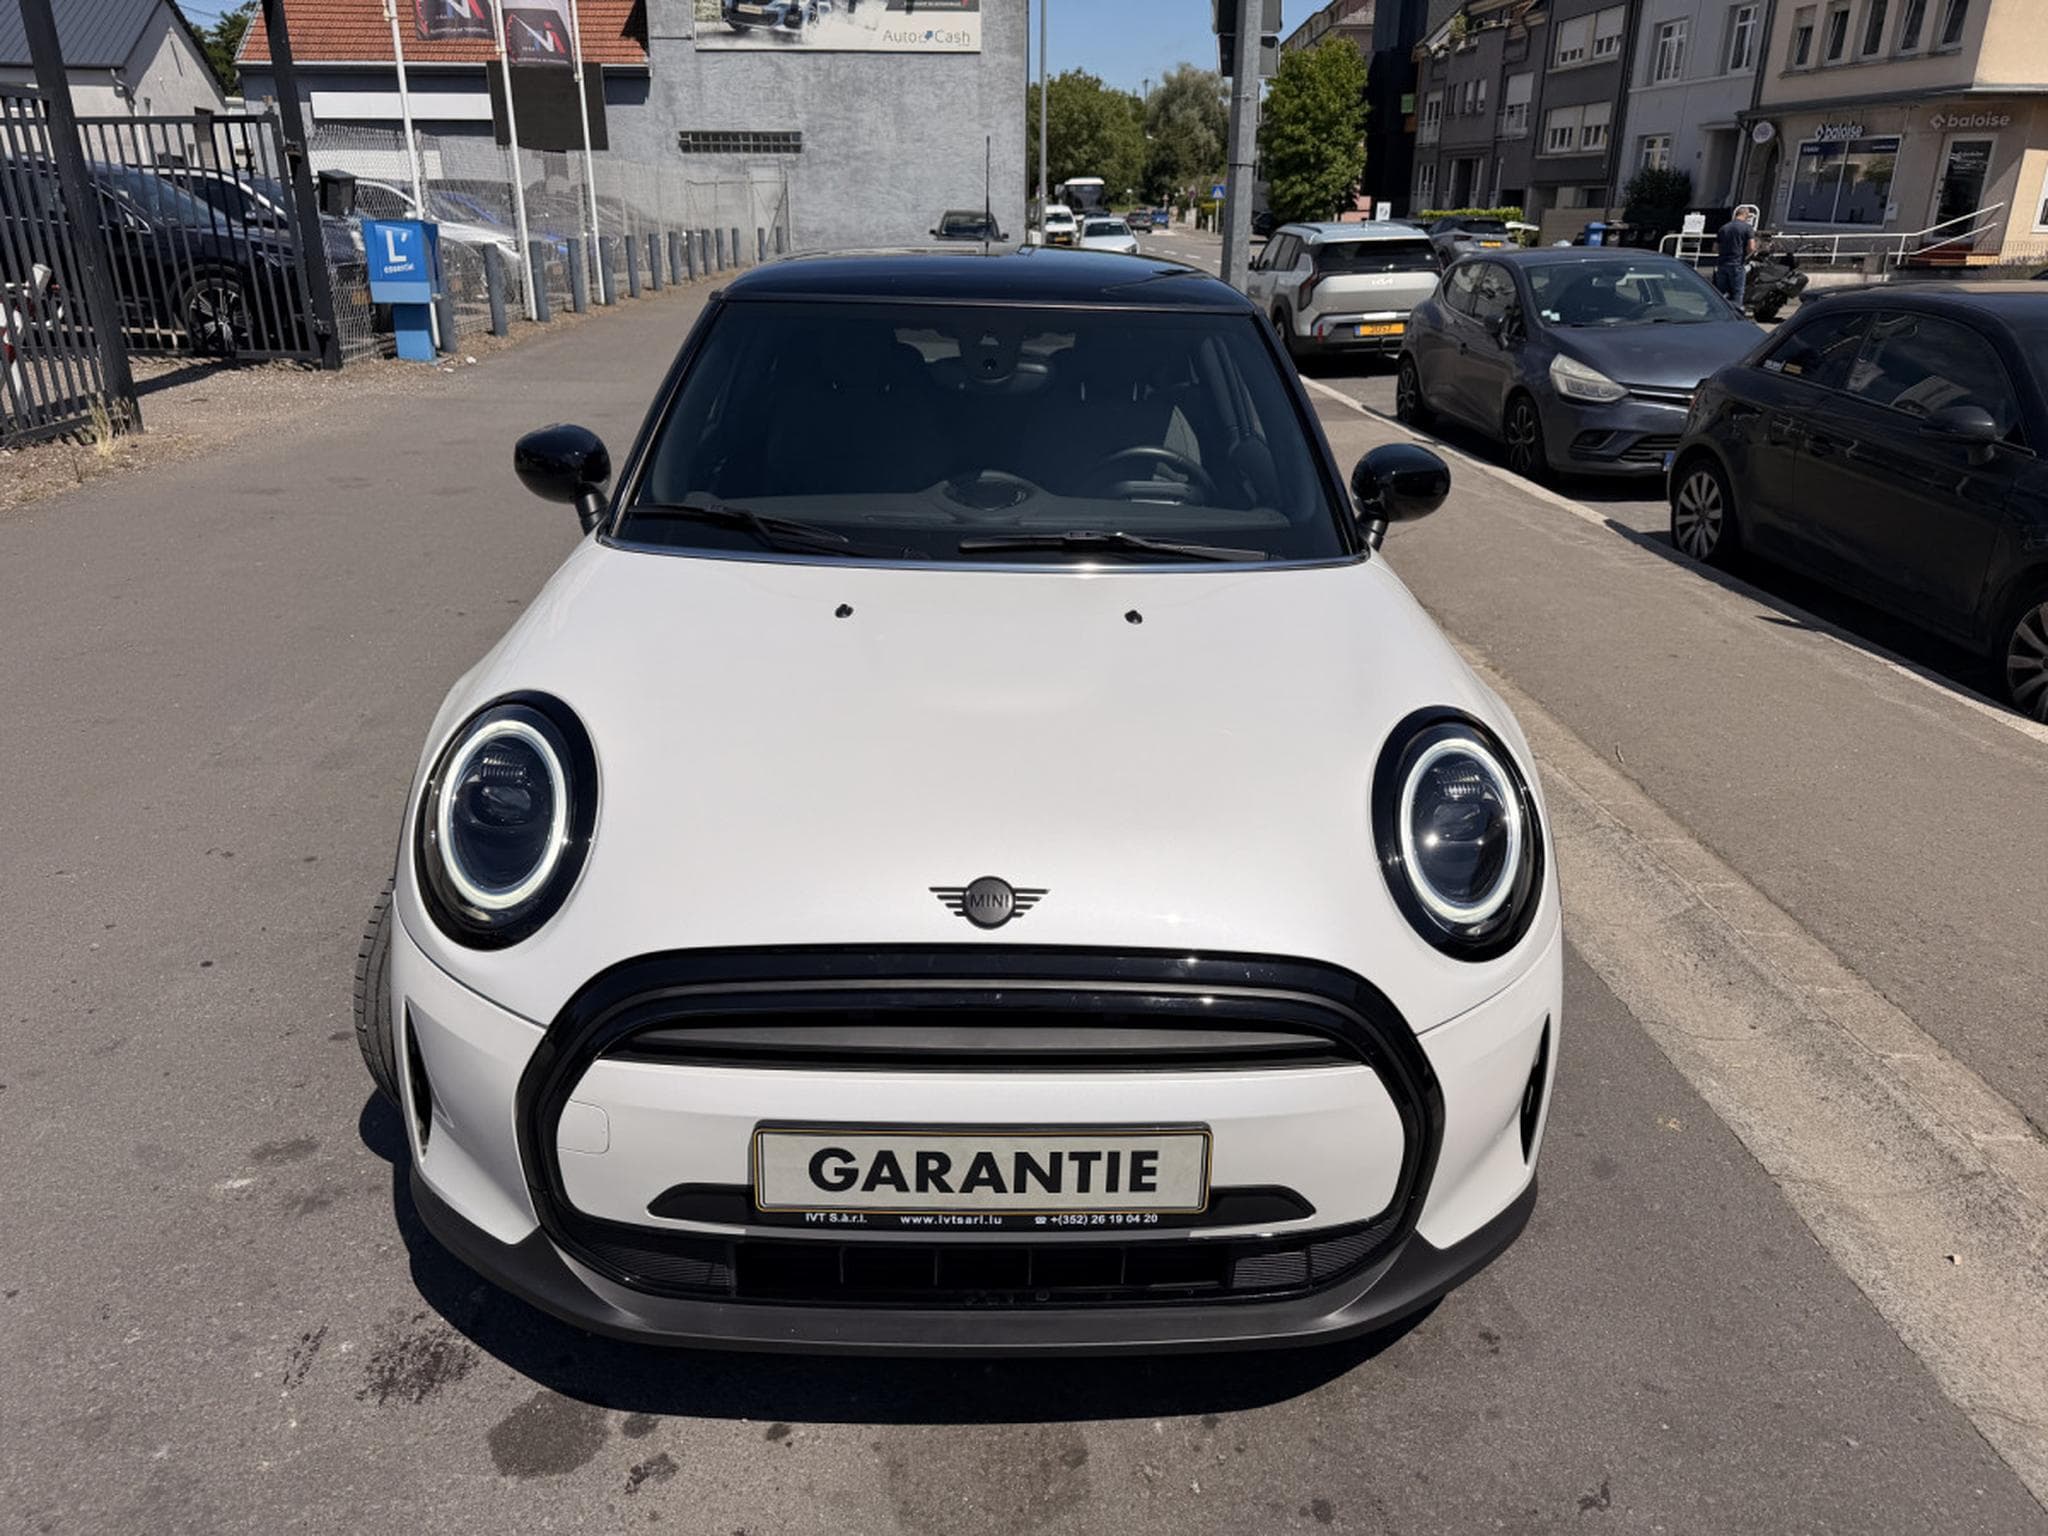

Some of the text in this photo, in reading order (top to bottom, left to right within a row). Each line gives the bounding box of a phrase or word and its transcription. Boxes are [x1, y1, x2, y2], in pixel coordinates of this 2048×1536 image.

[1947, 112, 2011, 127] baloise
[386, 230, 408, 263] L'
[970, 894, 1009, 908] MINI
[808, 1147, 1159, 1193] GARANTIE
[805, 1213, 825, 1222] IVT
[900, 1215, 1002, 1225] www.ivtsarl.lu
[1050, 1213, 1158, 1226] +(352) 26 19 04 20
